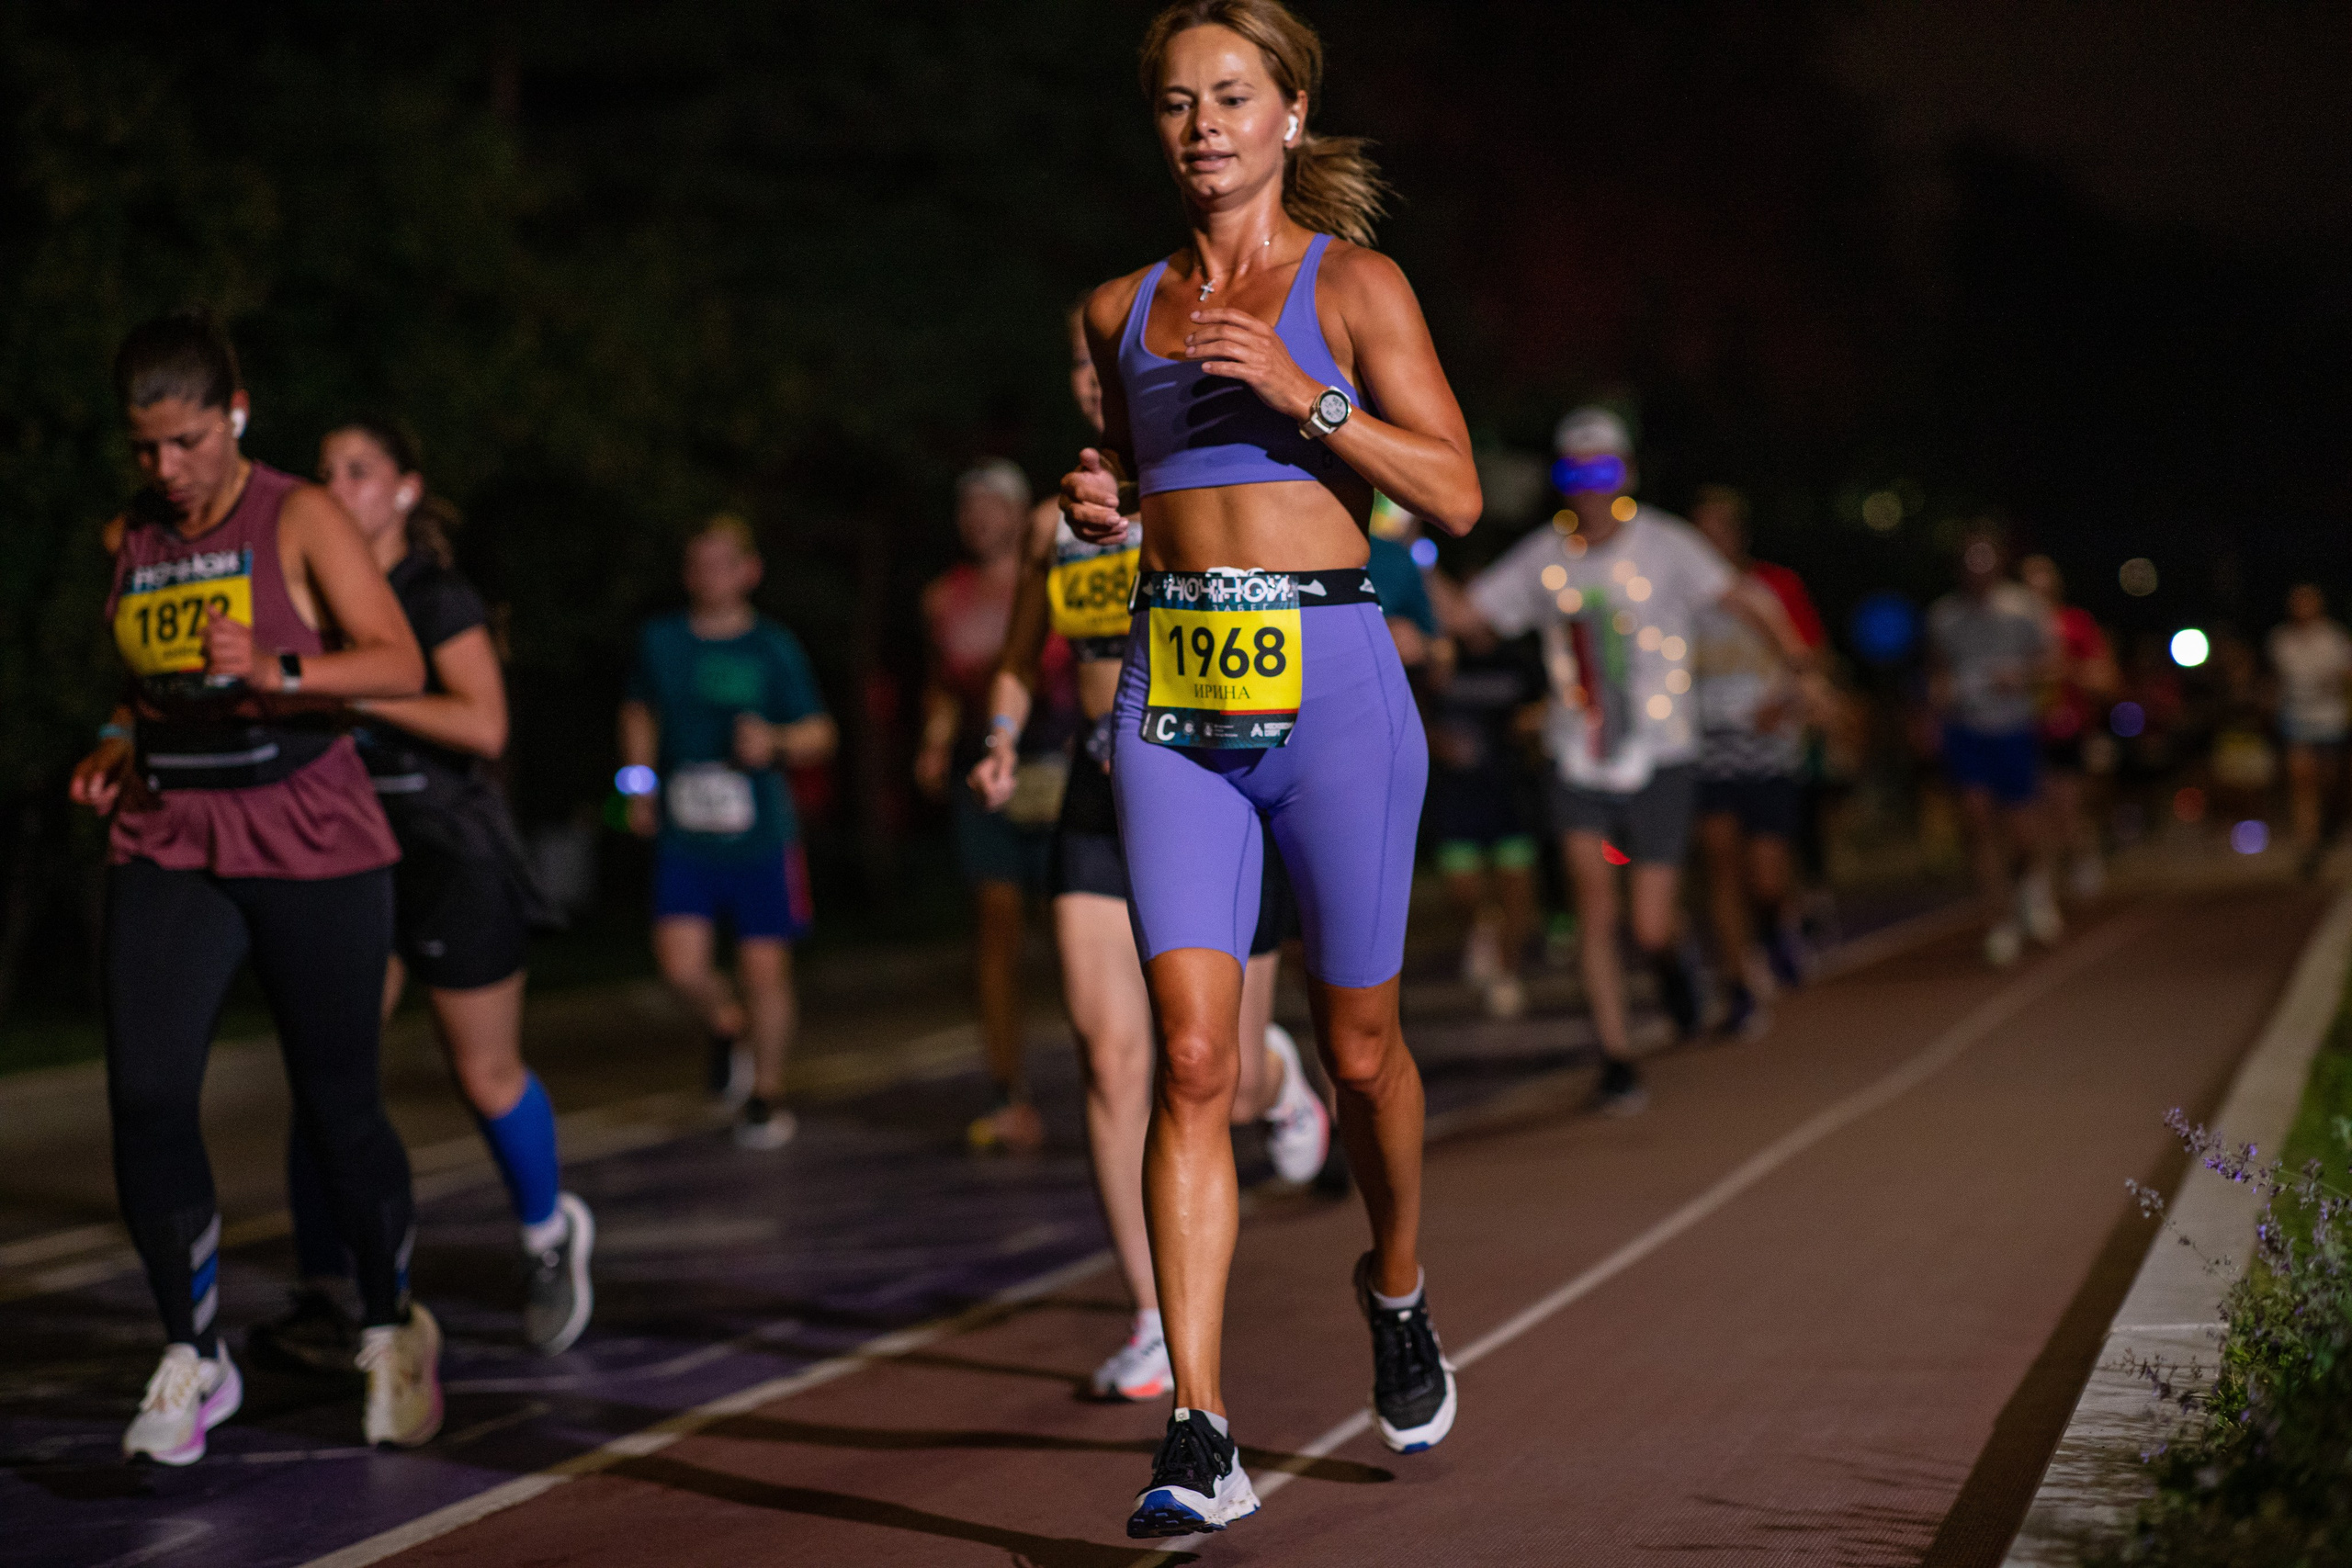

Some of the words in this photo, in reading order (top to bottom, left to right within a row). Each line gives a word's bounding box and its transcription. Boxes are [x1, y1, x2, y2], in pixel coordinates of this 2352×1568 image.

[1162, 576, 1295, 603] НОЧНОЙ
[1169, 626, 1287, 679] 1968
[1193, 683, 1250, 700] ИРИНА
